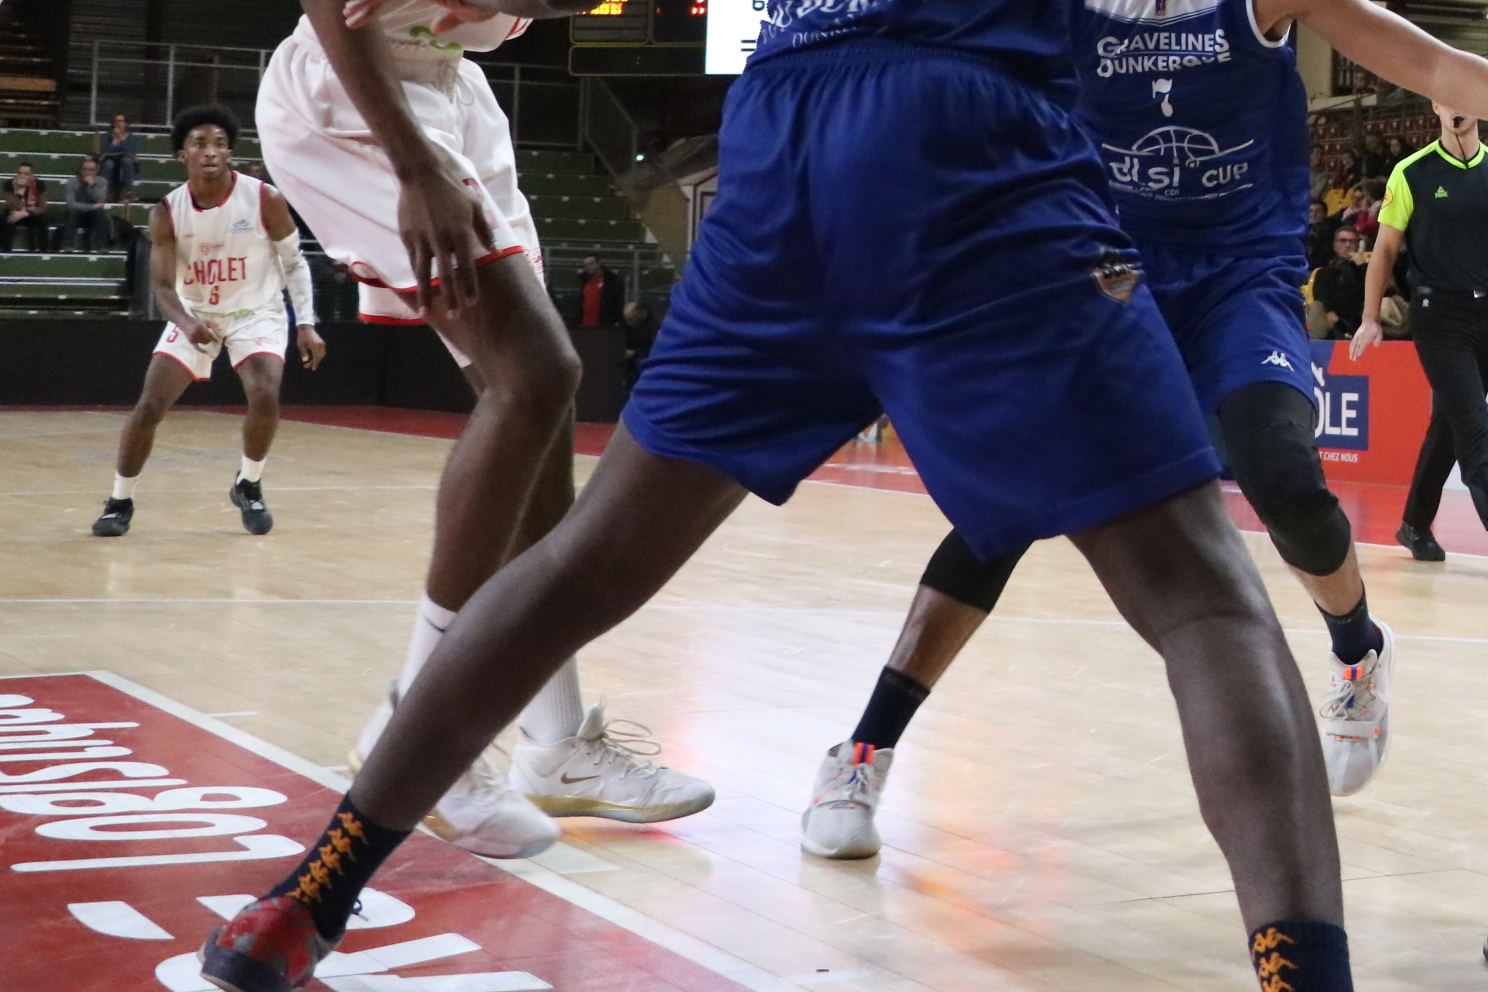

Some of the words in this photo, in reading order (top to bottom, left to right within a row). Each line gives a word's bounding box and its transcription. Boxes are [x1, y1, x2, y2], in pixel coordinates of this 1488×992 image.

[1096, 28, 1230, 58] GRAVELINES
[1151, 78, 1174, 118] 7
[1201, 161, 1249, 188] CUP
[183, 256, 248, 286] CHOLET
[1323, 451, 1340, 461] CHEZ
[1340, 452, 1359, 462] NOUS
